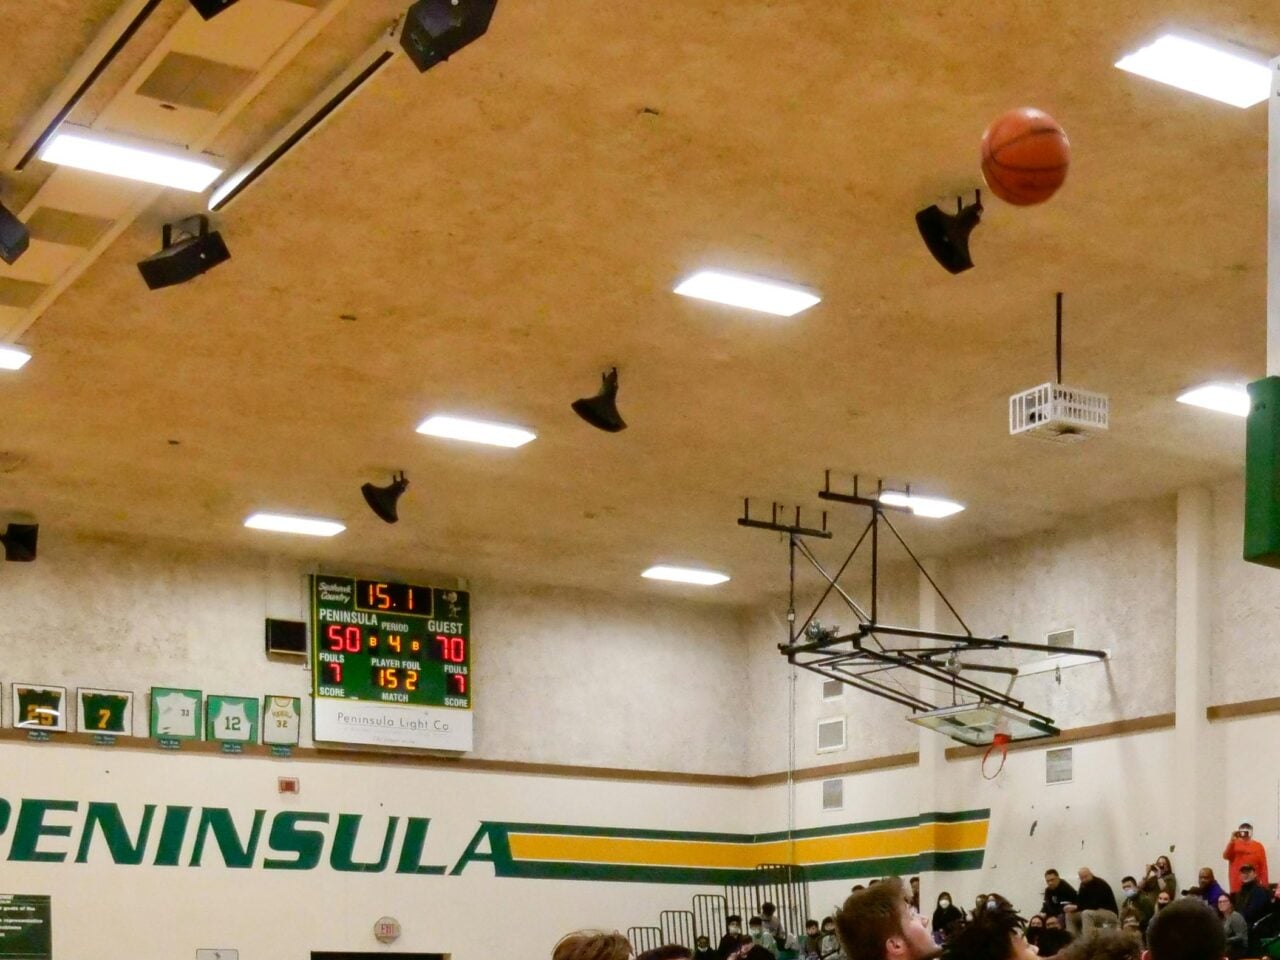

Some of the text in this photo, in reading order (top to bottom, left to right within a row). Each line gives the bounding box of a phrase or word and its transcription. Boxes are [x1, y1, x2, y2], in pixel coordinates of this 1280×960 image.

[319, 609, 378, 626] PENINSULA
[381, 621, 409, 633] PERIOD
[428, 620, 464, 634] GUEST
[328, 625, 361, 653] 50
[389, 634, 400, 652] 4
[436, 635, 465, 662] 70
[319, 652, 345, 664] FOULS
[371, 658, 421, 671] PLAYER FOUL
[331, 663, 341, 682] 7
[444, 665, 468, 675] FOULS
[455, 674, 464, 693] 7
[319, 687, 345, 697] SCORE
[382, 693, 409, 702] MATCH
[444, 697, 468, 707] SCORE
[98, 708, 111, 729] 7
[225, 716, 241, 731] 12
[337, 712, 395, 727] Peninsula
[400, 717, 428, 731] Light
